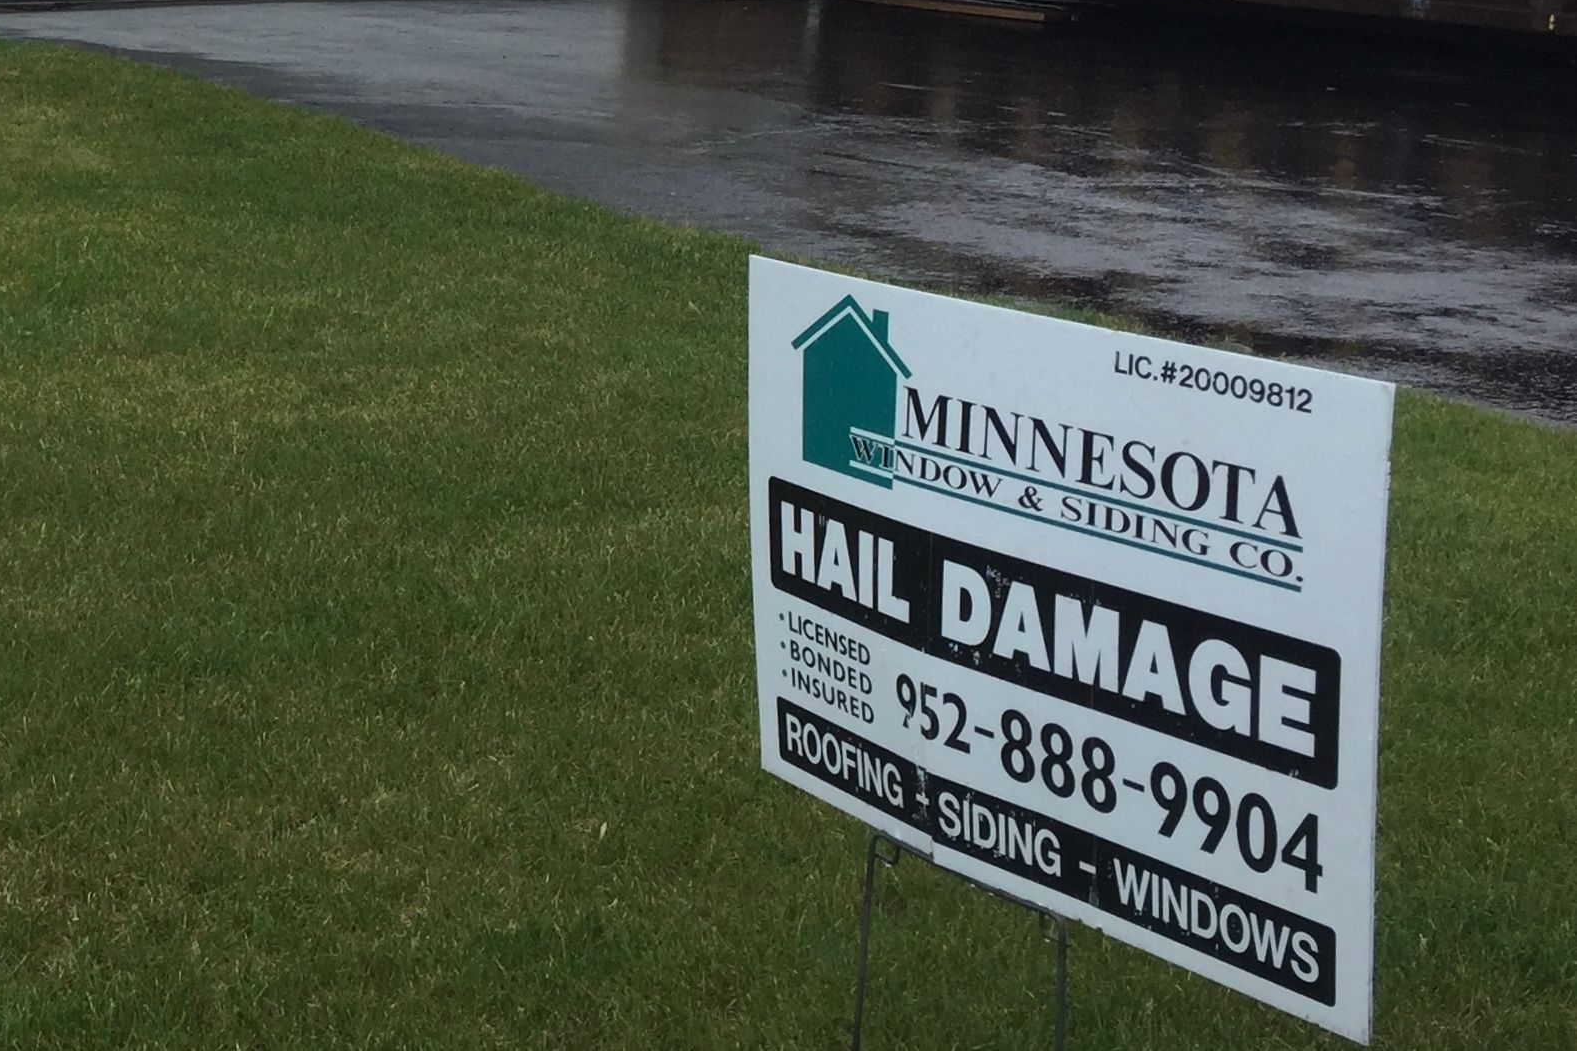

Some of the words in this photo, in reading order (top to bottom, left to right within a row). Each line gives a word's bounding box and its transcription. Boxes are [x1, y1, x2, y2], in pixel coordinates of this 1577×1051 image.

[1114, 350, 1313, 414] LIC.#20009812
[849, 433, 1004, 498] WINDOW
[1017, 485, 1044, 512] &
[1060, 496, 1211, 556] SIDING
[1228, 541, 1305, 583] CO.
[901, 385, 1303, 539] MINNESOTA
[779, 501, 910, 623] HAIL
[940, 559, 1317, 758] DAMAGE
[787, 611, 871, 666] LICENSED
[789, 639, 873, 695] BONDED
[790, 668, 874, 724] INSURED
[785, 712, 904, 809] ROOFING
[937, 791, 1061, 877] SIDING
[1113, 858, 1320, 984] WINDOWS
[895, 673, 1323, 894] 952-888-9904
